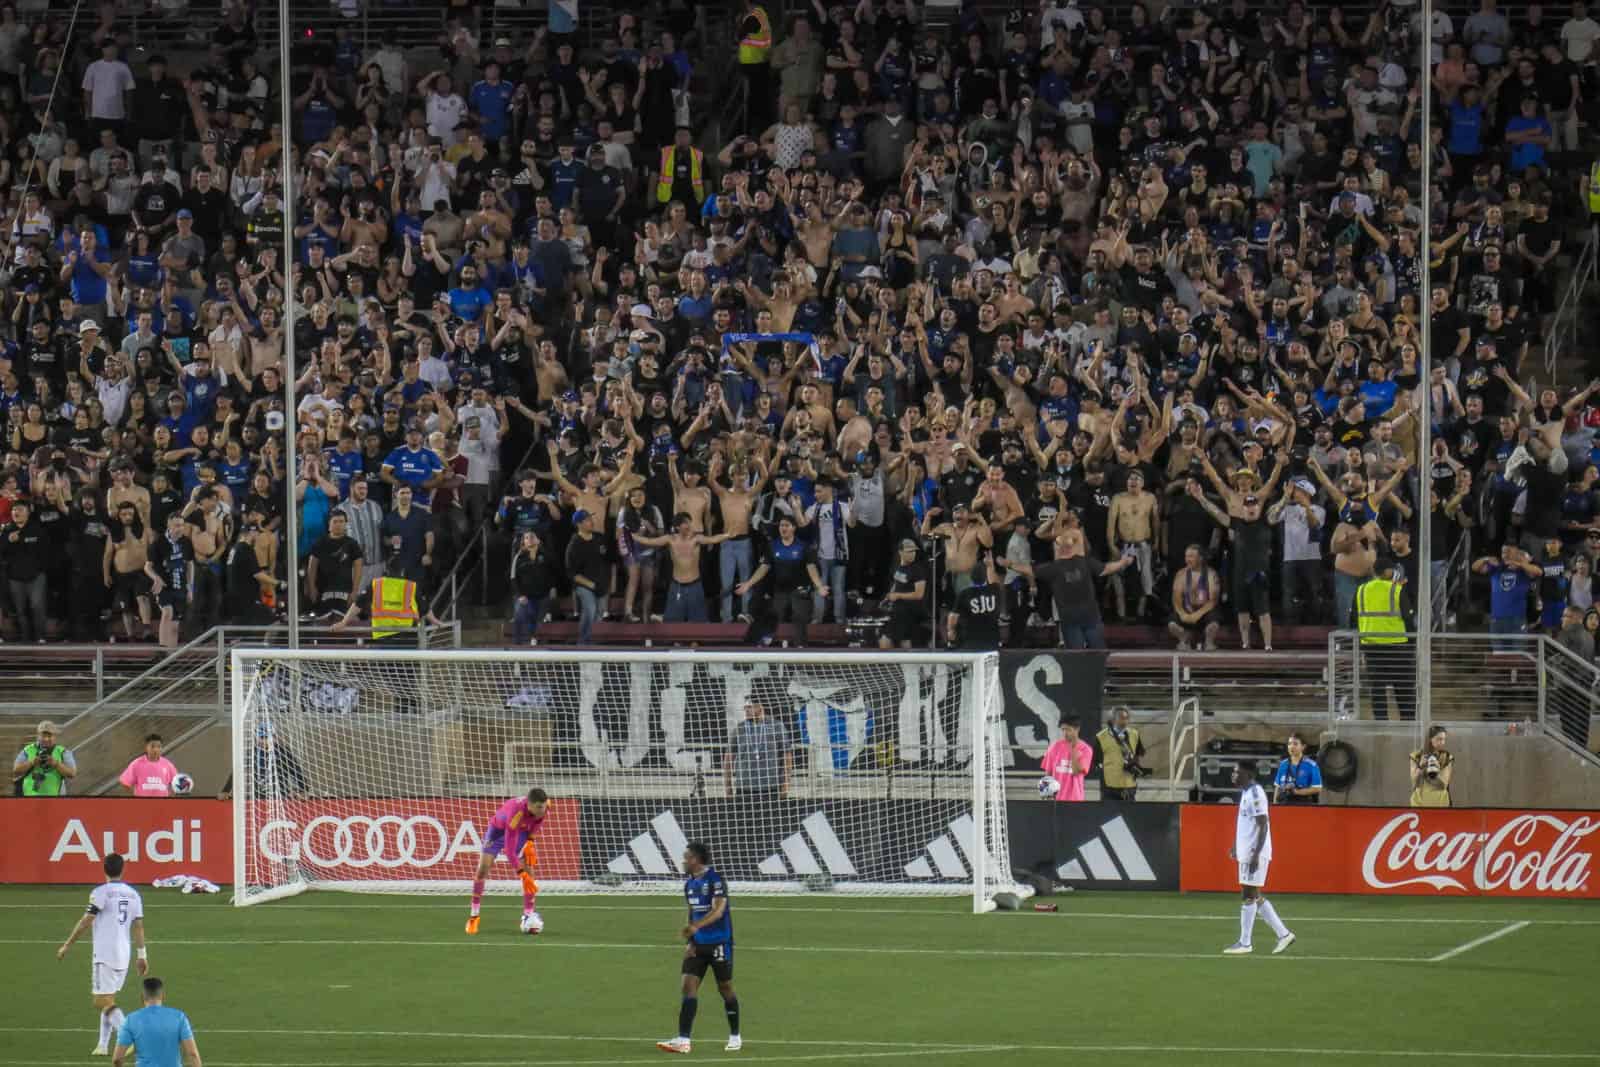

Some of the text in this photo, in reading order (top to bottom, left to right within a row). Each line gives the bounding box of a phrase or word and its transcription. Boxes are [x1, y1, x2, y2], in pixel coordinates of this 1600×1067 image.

[970, 595, 996, 614] SJU
[48, 819, 202, 863] Audi
[259, 815, 511, 867] GOOOOA
[1362, 813, 1600, 891] Coca-Cola
[118, 900, 129, 925] 5
